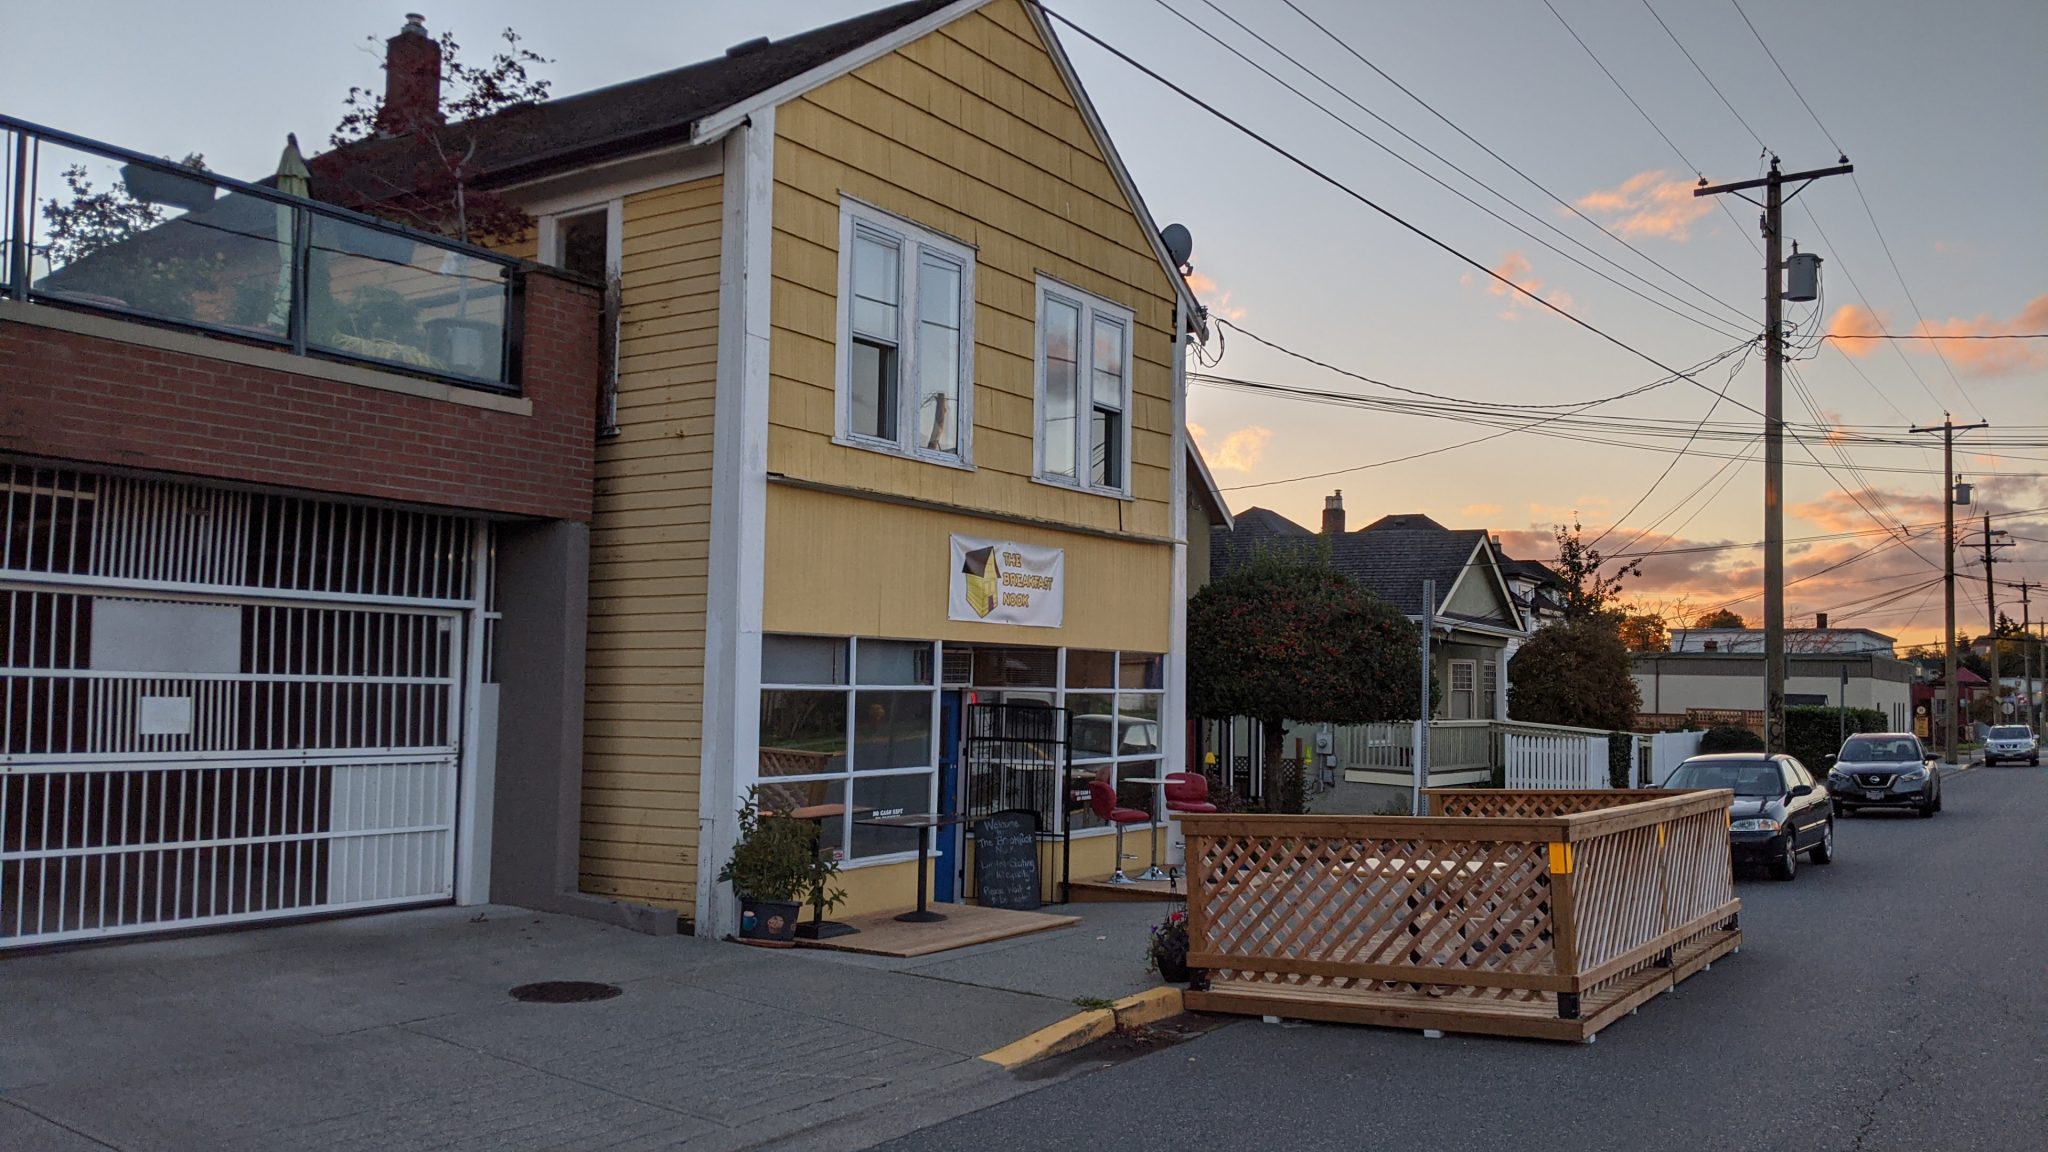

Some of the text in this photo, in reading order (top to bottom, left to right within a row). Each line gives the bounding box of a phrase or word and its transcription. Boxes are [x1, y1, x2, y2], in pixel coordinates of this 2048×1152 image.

[1003, 552, 1021, 567] THE
[1003, 572, 1053, 591] BREAKFAST
[1003, 592, 1029, 608] NOOK
[984, 818, 1020, 831] Welcome
[978, 838, 994, 849] The
